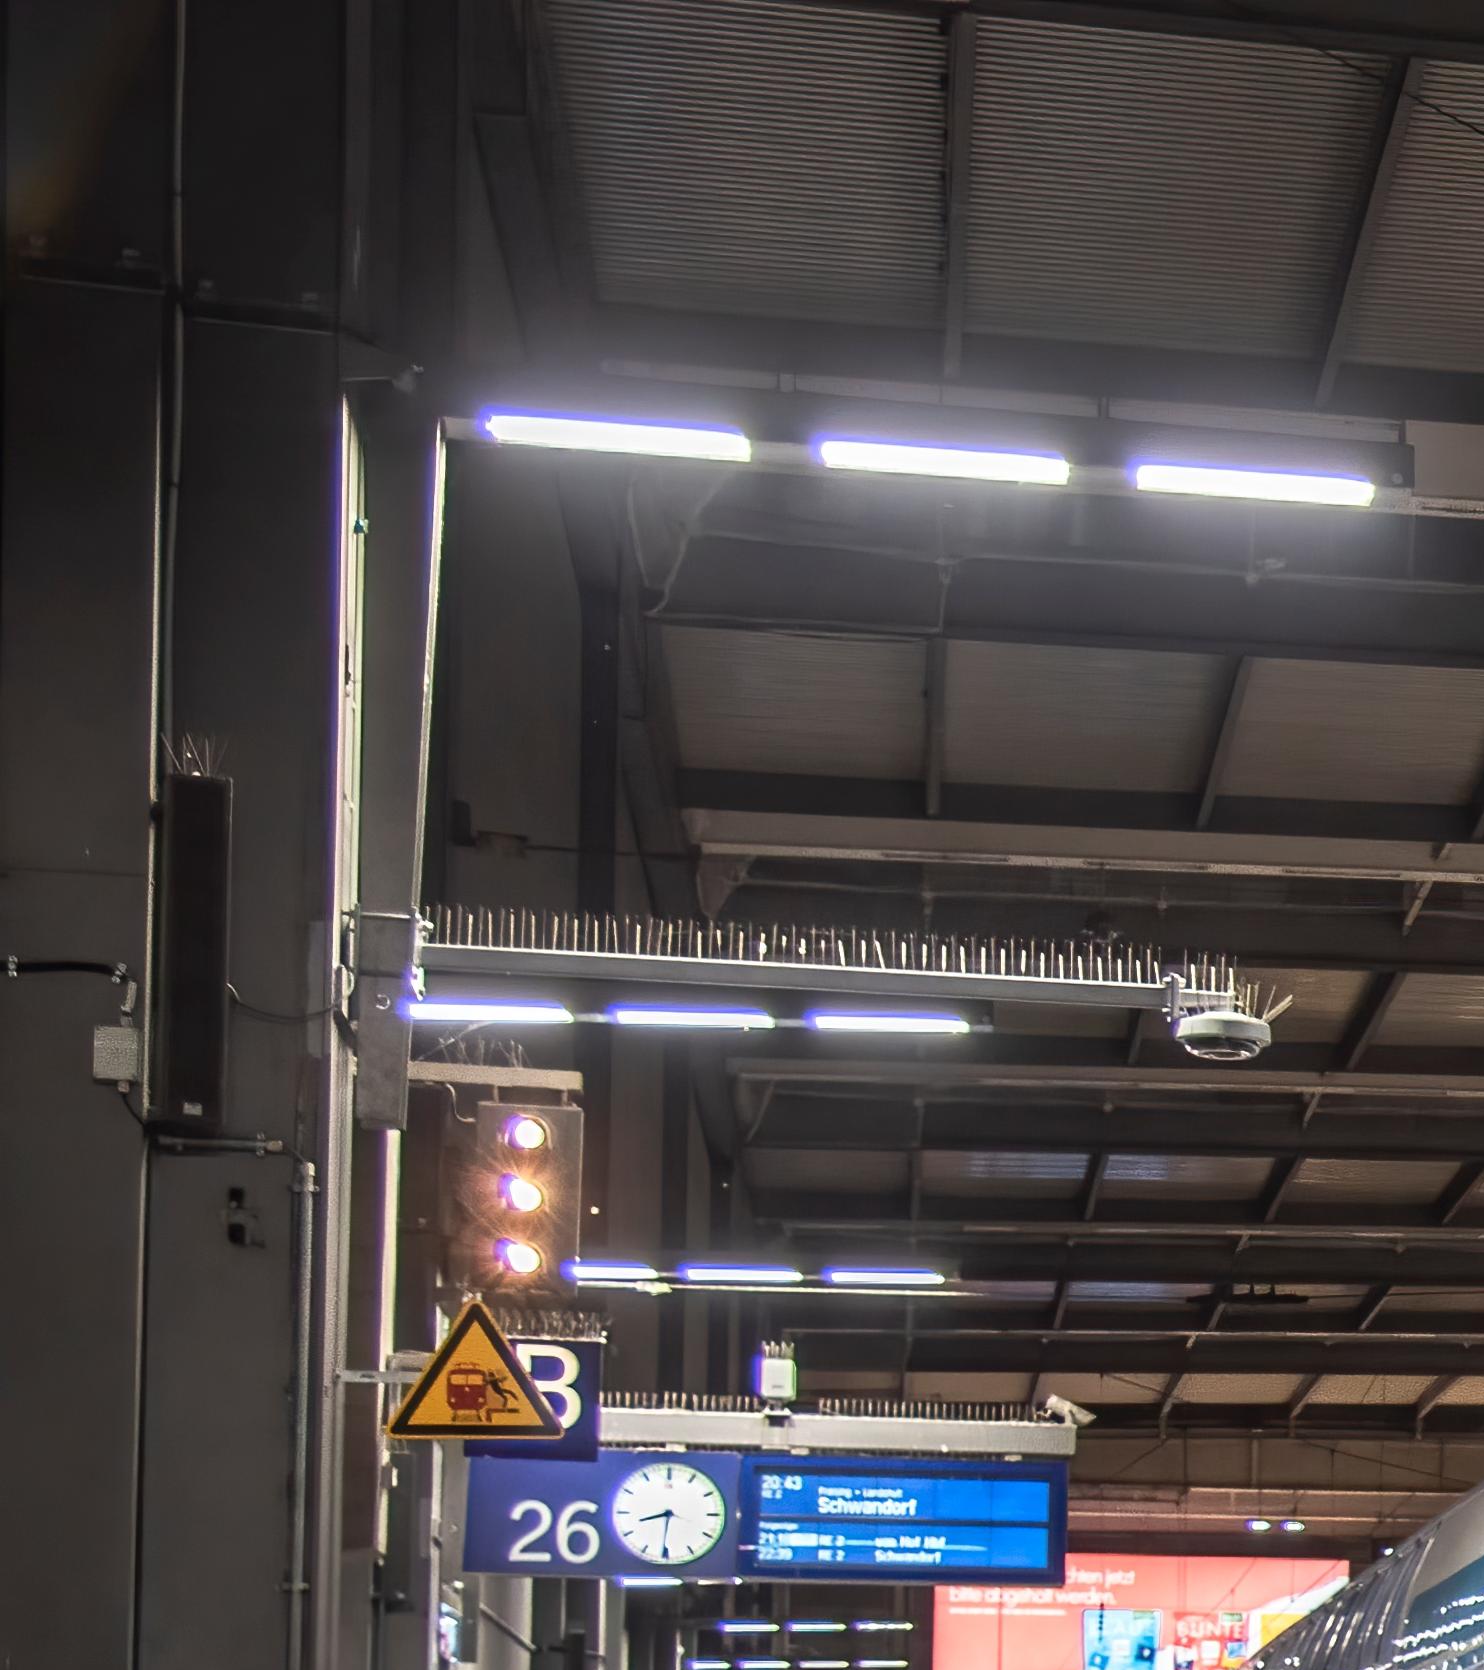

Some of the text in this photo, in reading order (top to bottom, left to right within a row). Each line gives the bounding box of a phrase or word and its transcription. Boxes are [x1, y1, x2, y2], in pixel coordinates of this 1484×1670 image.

[516, 1344, 581, 1430] B
[507, 1499, 600, 1563] 26
[818, 1496, 917, 1516] Schwandorf
